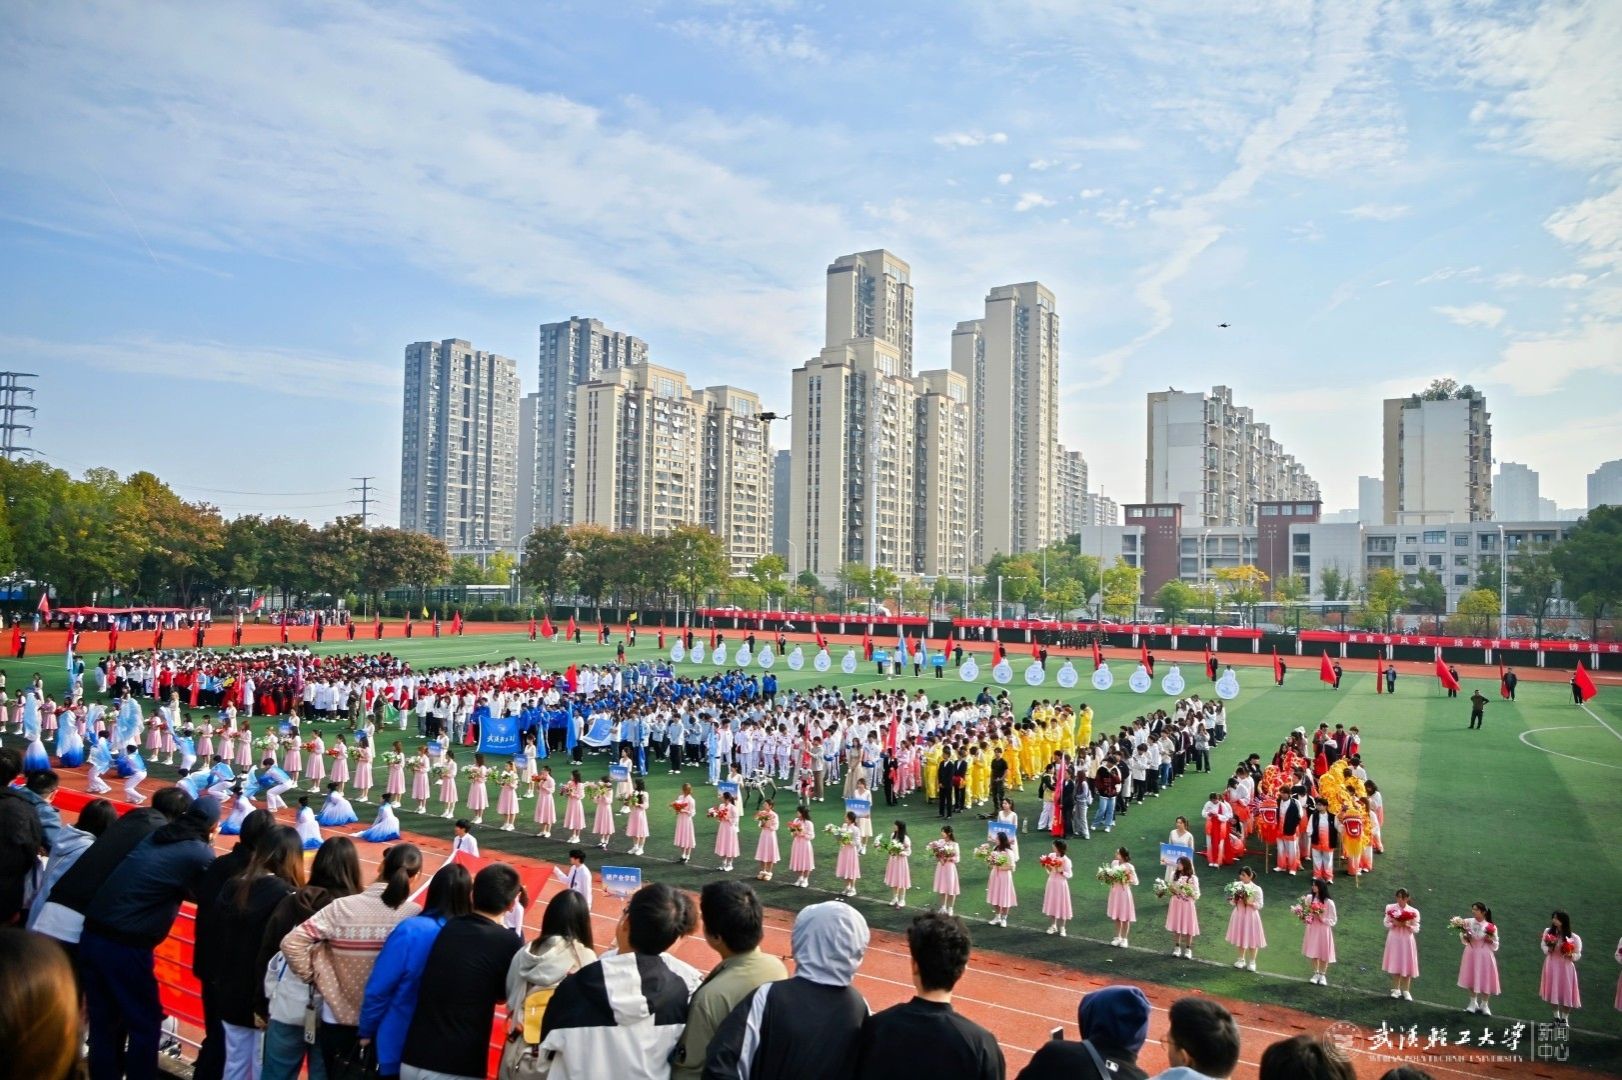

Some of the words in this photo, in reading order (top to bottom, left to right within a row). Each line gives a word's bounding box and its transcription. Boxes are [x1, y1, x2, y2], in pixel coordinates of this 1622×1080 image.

[1348, 635, 1428, 645] 展青春风采
